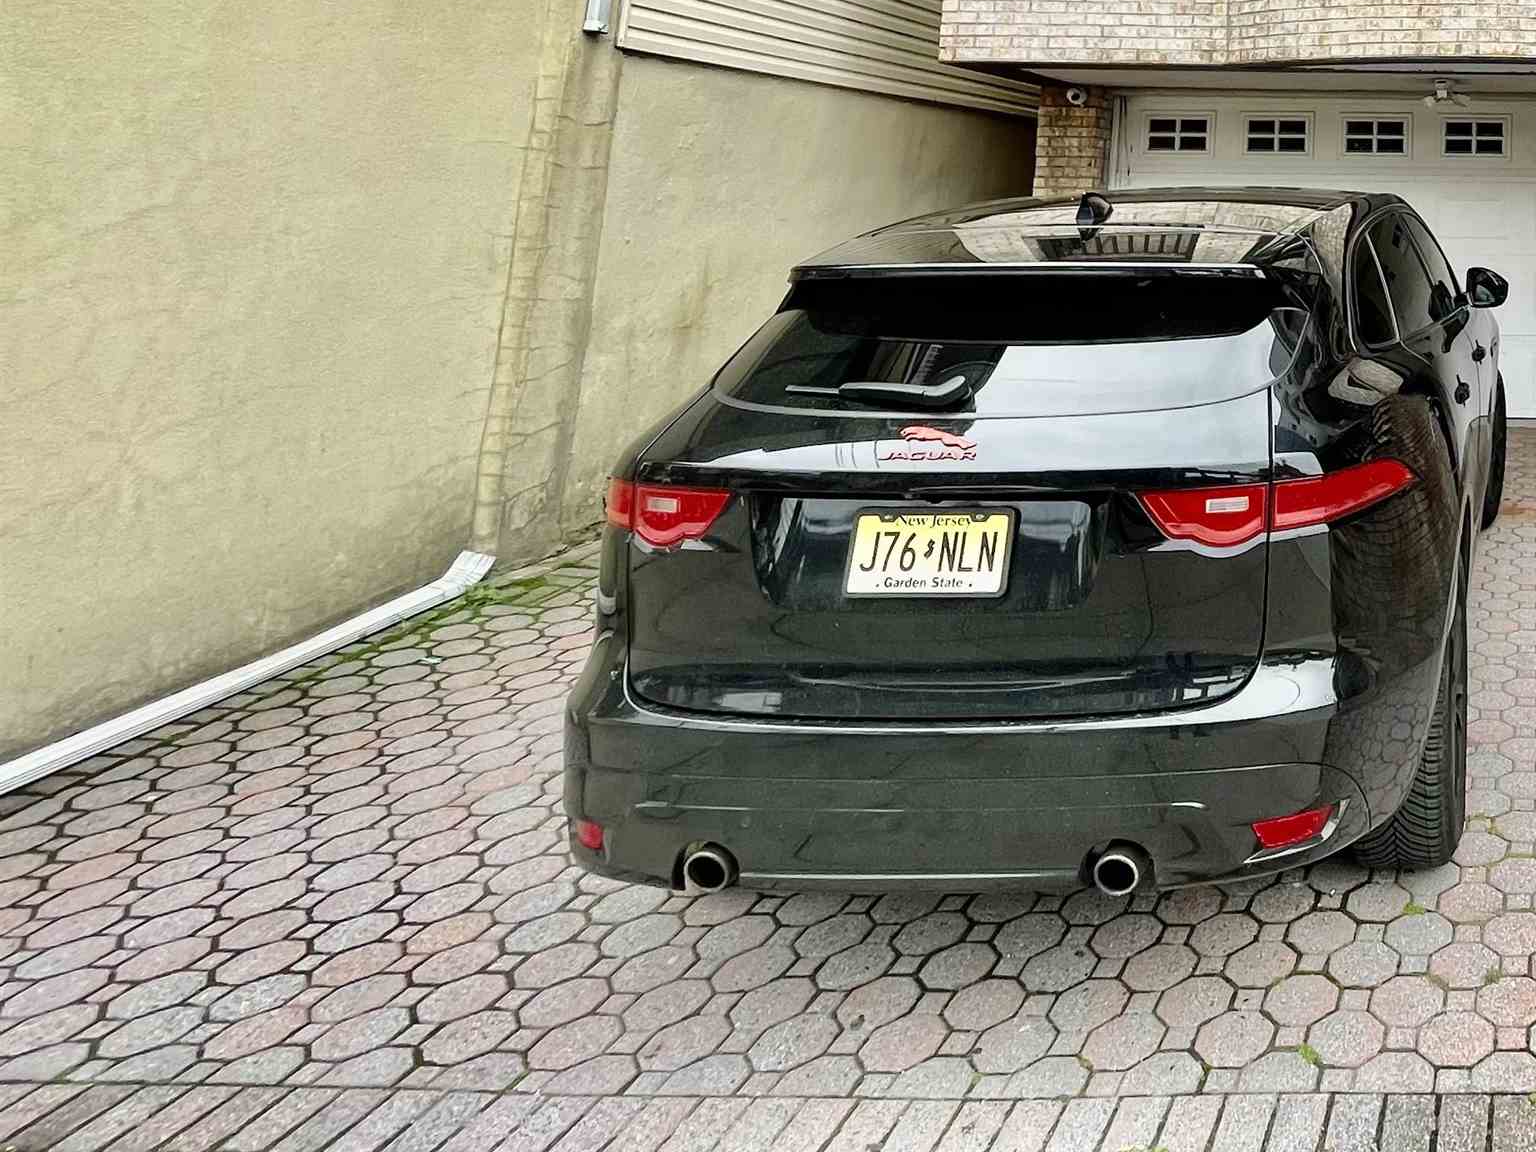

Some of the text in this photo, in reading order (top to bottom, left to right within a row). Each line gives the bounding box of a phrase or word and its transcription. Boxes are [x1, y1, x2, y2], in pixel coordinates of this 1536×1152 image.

[878, 451, 977, 461] JAGUAR
[896, 515, 928, 527] New
[884, 576, 964, 589] Garden State
